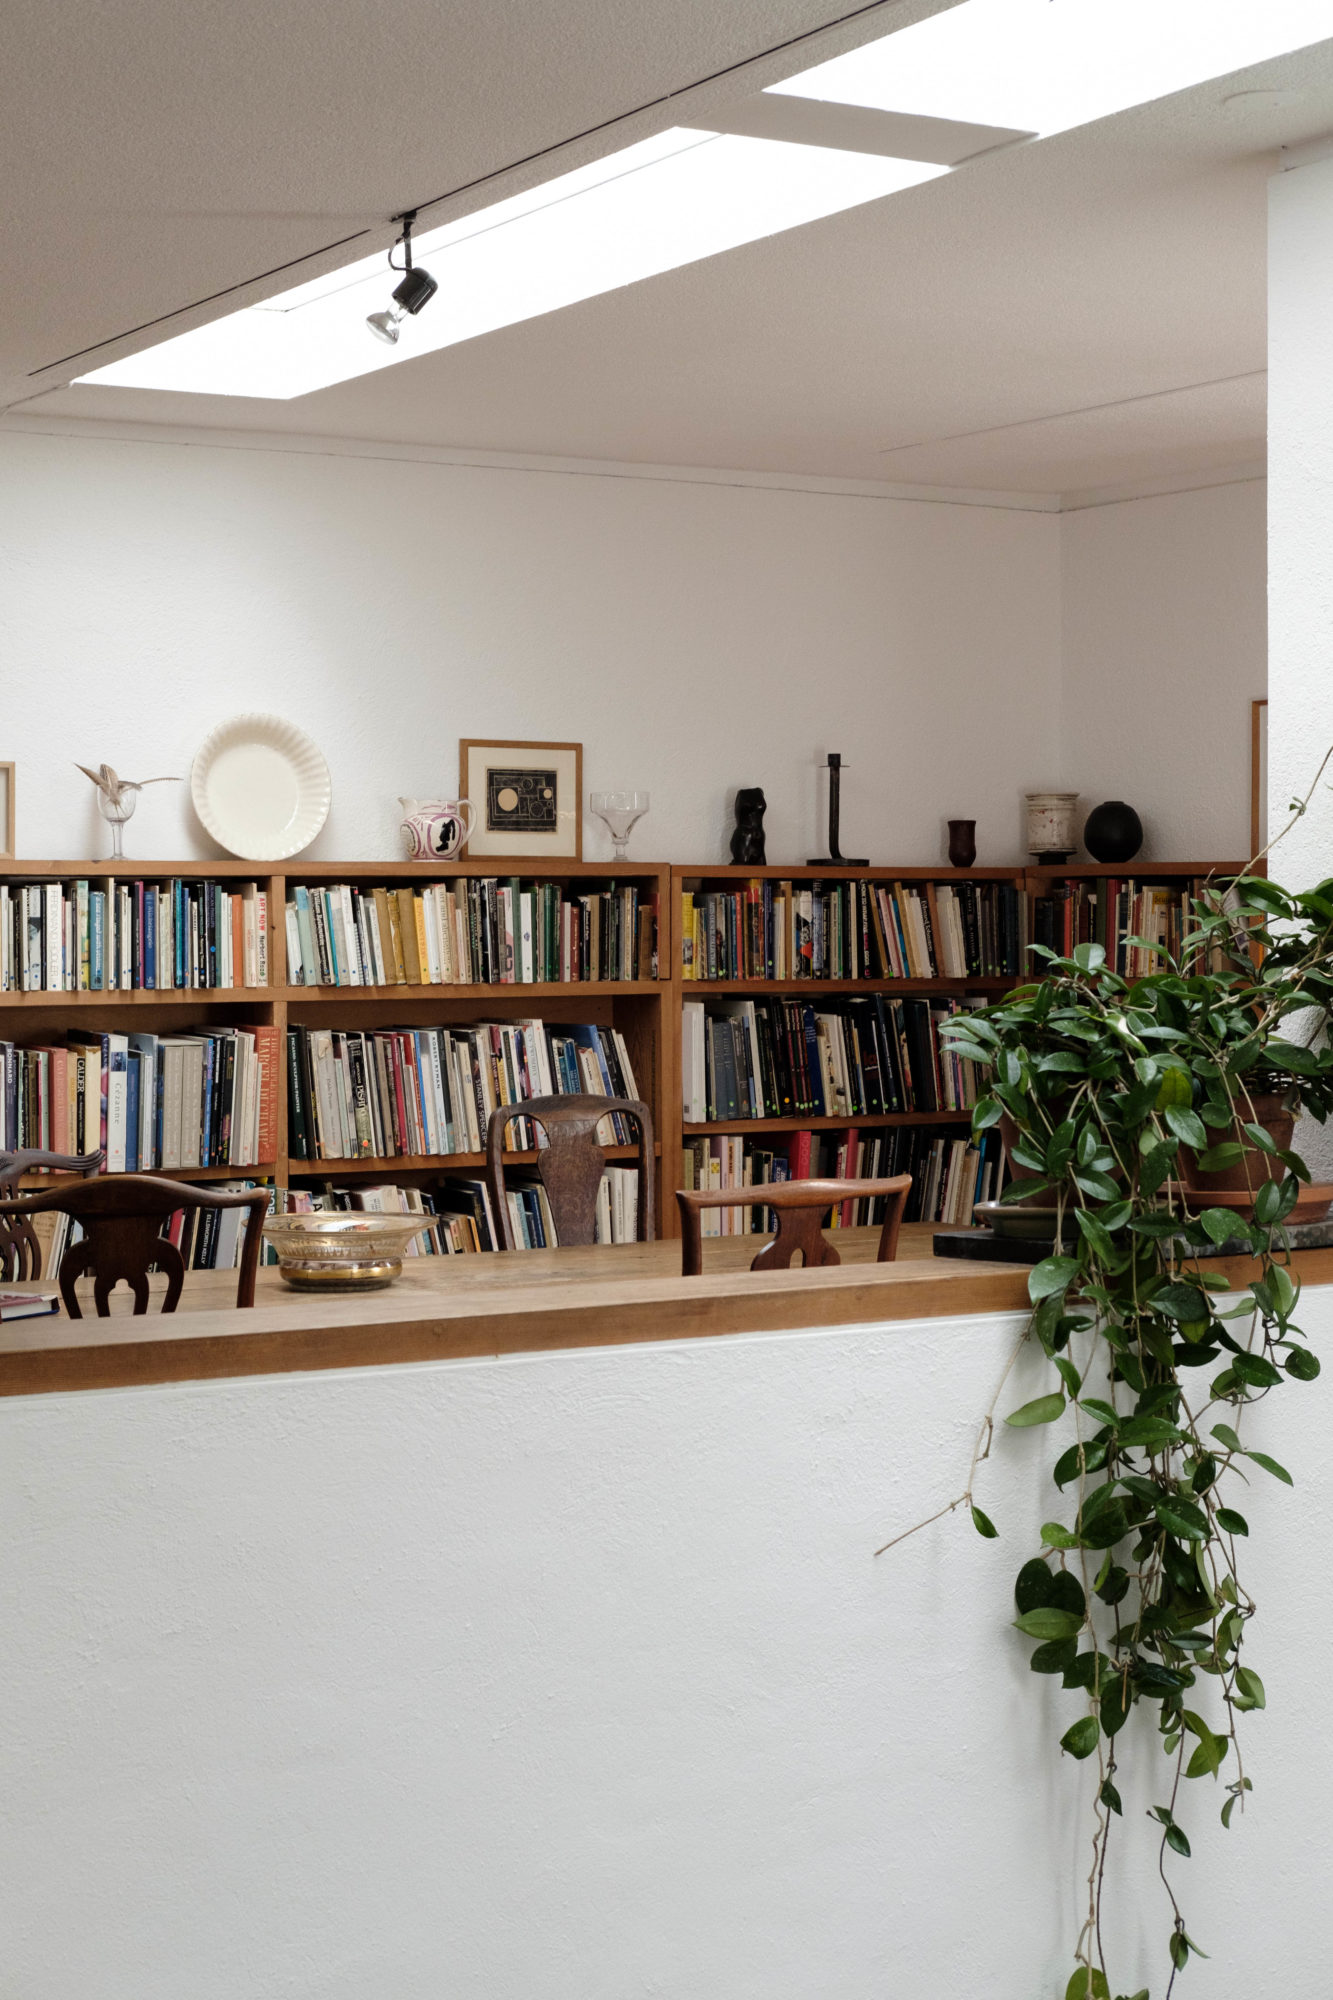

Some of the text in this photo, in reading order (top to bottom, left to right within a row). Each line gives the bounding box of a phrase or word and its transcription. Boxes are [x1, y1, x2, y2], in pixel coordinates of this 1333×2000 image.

[77, 1060, 85, 1092] CALDER
[259, 1037, 270, 1145] MARCEL DUCHAMP
[114, 1082, 122, 1125] Cézanne
[475, 1079, 487, 1140] STANLEY SPENCER
[200, 1213, 212, 1264] ELLSWORTH KELLY
